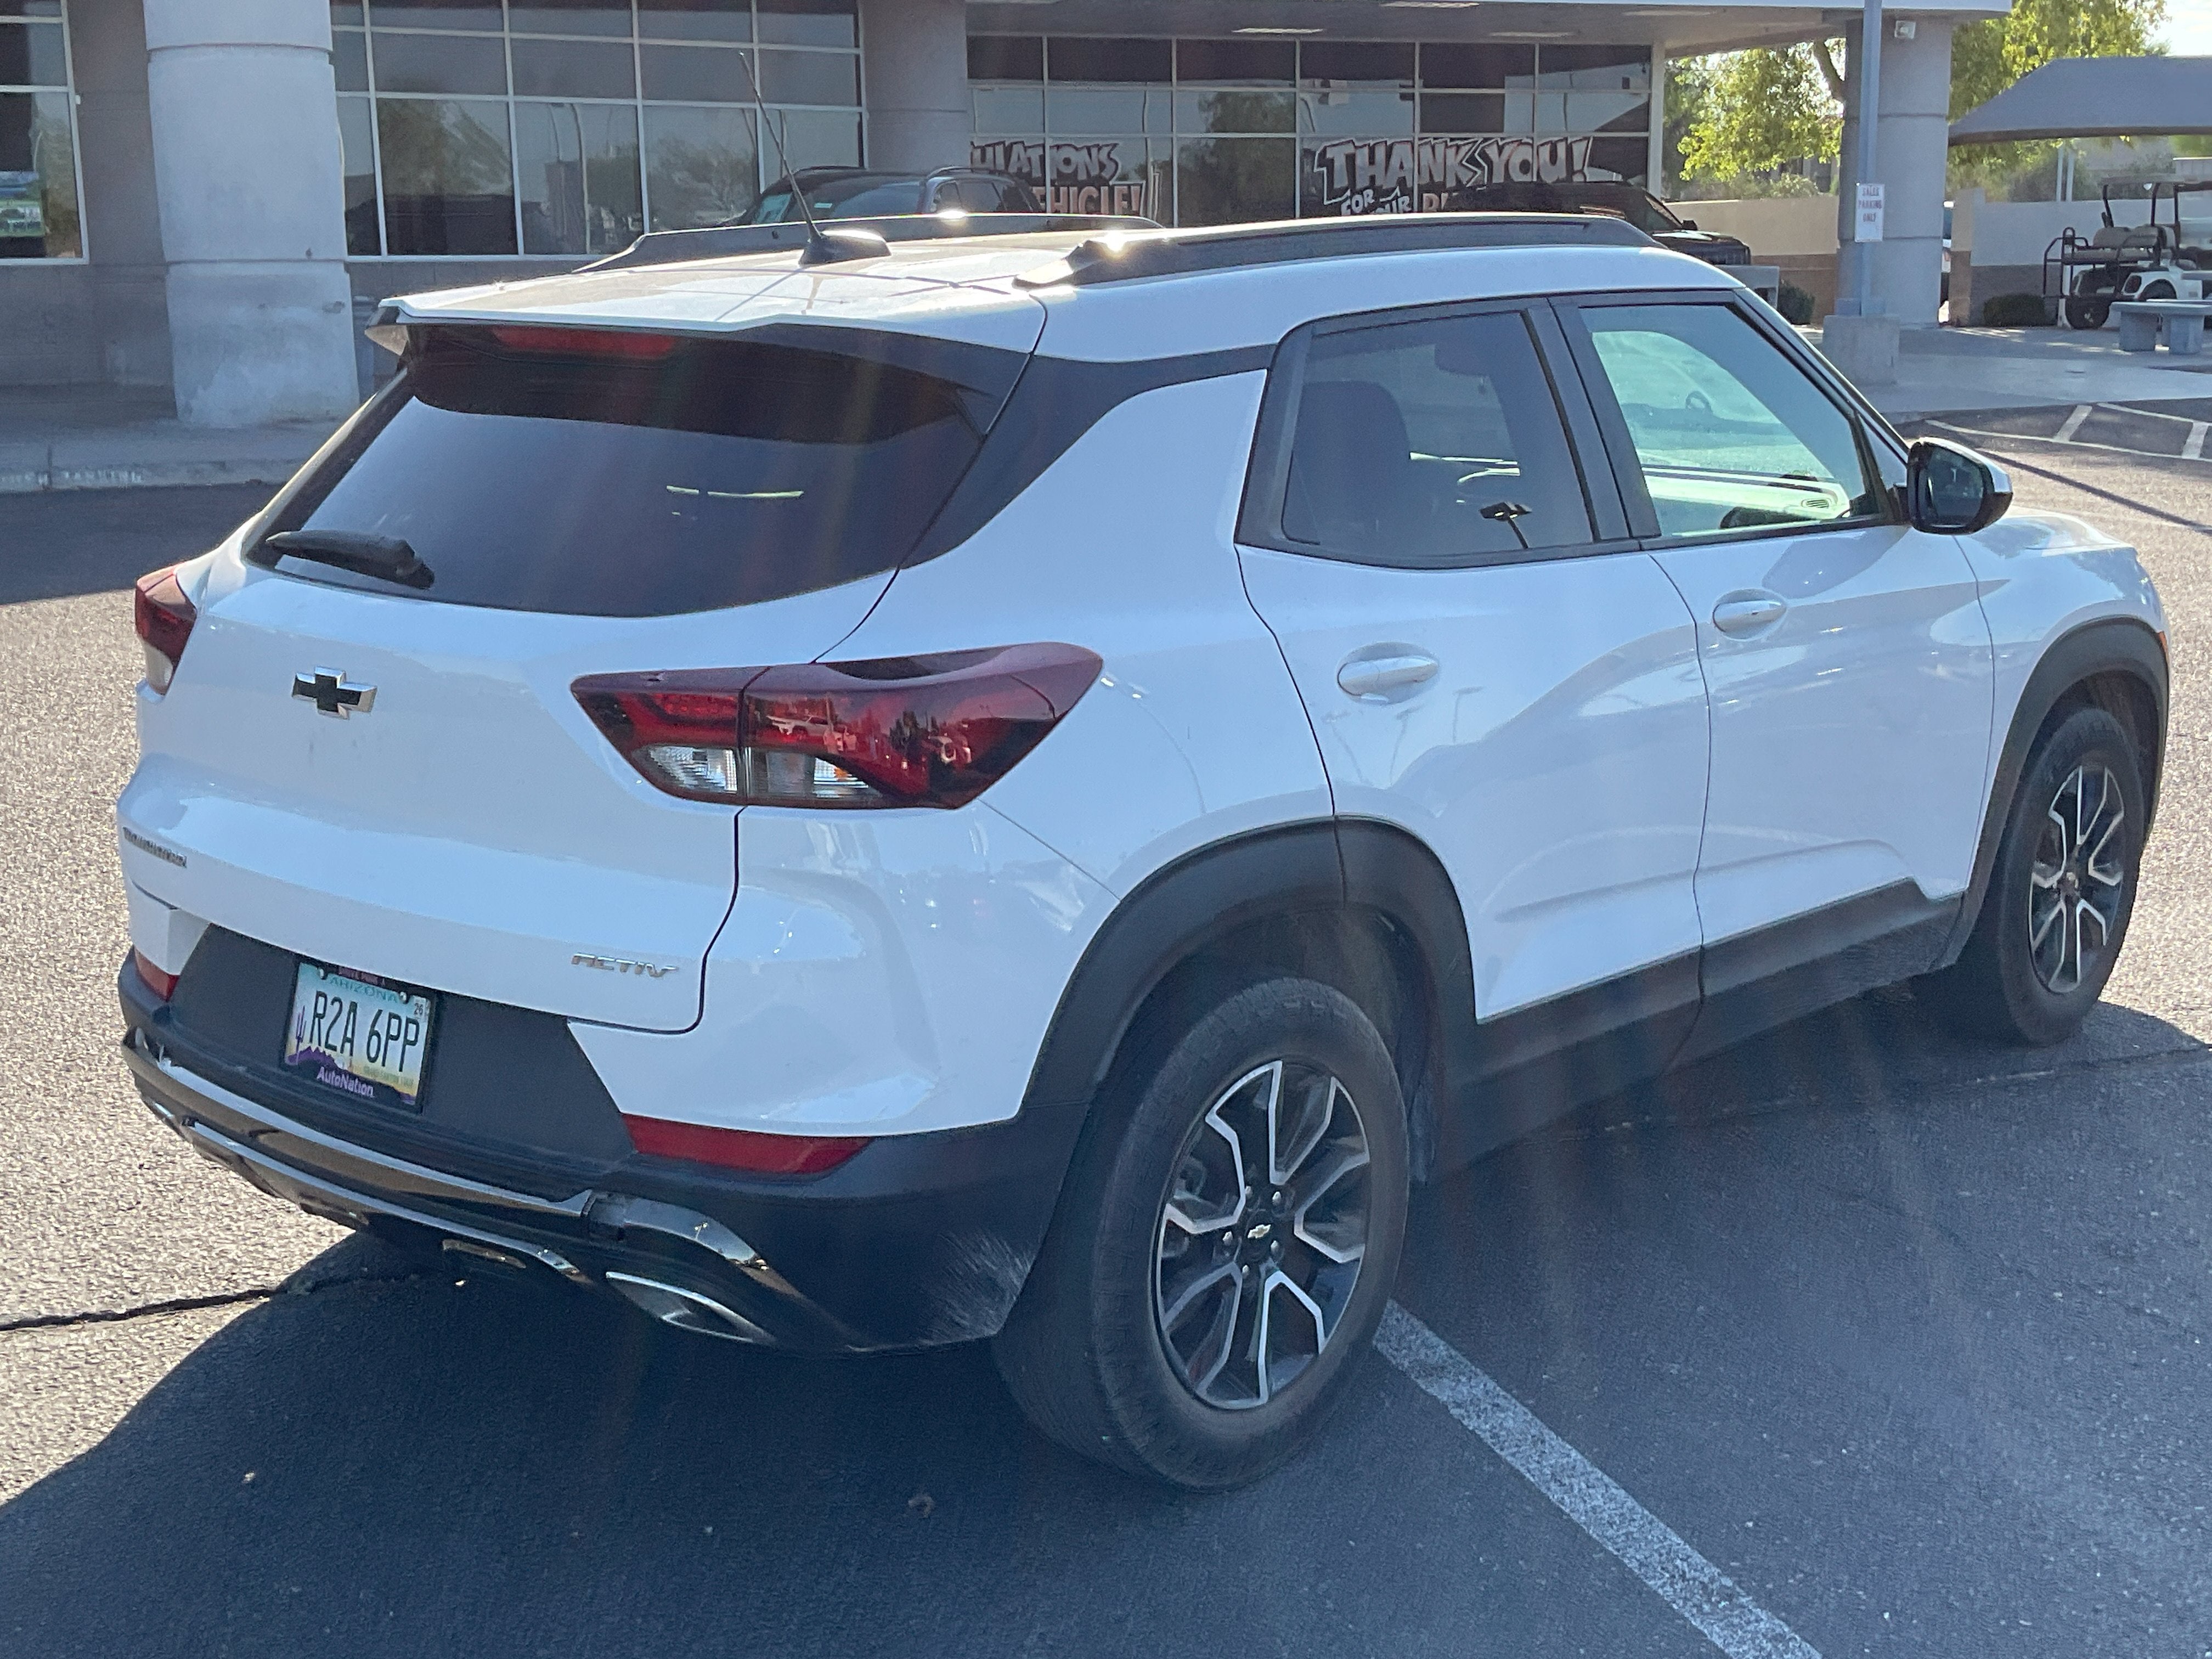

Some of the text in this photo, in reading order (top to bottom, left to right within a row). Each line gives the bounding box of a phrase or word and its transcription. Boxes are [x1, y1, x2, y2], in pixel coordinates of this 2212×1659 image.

[1326, 138, 1591, 188] THANK YOU!
[329, 975, 398, 1003] ARIZONA
[309, 990, 420, 1072] R2A 6PP
[316, 1066, 375, 1097] AutoNation
